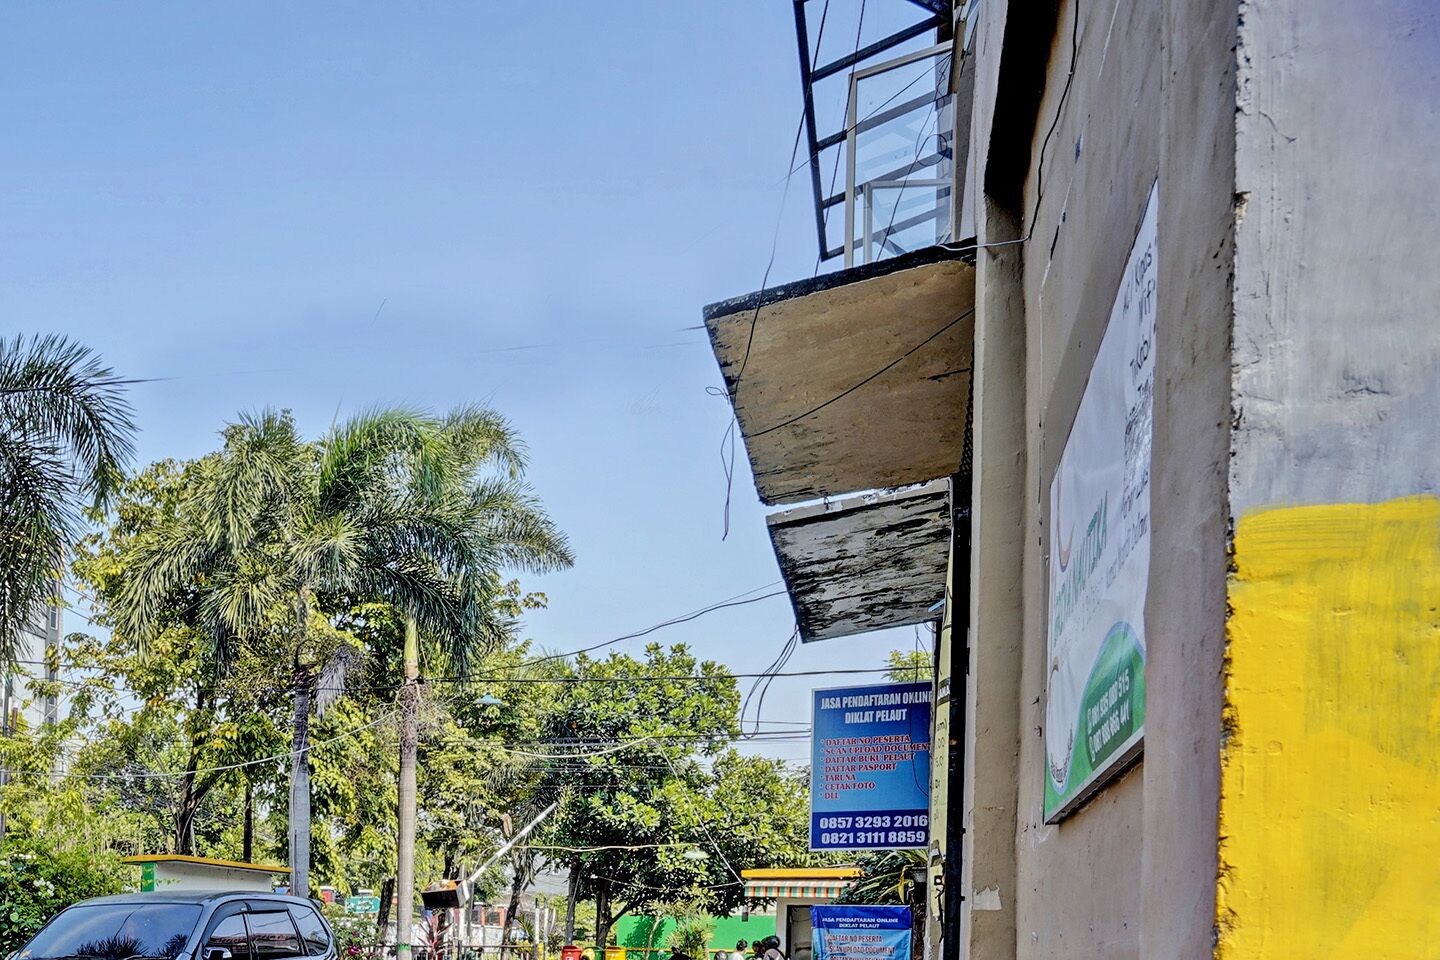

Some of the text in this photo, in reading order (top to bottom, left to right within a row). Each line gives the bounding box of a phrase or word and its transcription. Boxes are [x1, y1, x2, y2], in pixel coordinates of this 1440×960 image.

[821, 697, 841, 710] JASA
[842, 692, 901, 708] PENDAFTARAN
[845, 708, 907, 724] DIKLAT PELAUT
[825, 735, 911, 746] DAFTAR NO PESERTA
[825, 747, 847, 755] SCAN
[849, 745, 882, 754] UPLOAD
[825, 752, 915, 764] DAFTAR BUKU PELAUT
[825, 763, 897, 773] DAFTAR PASPORT
[825, 774, 856, 782] TARUNA
[824, 782, 875, 791] CETAK FOTO
[820, 815, 928, 829] 0857 3293 2016
[821, 830, 926, 844] 0821 3111 8859
